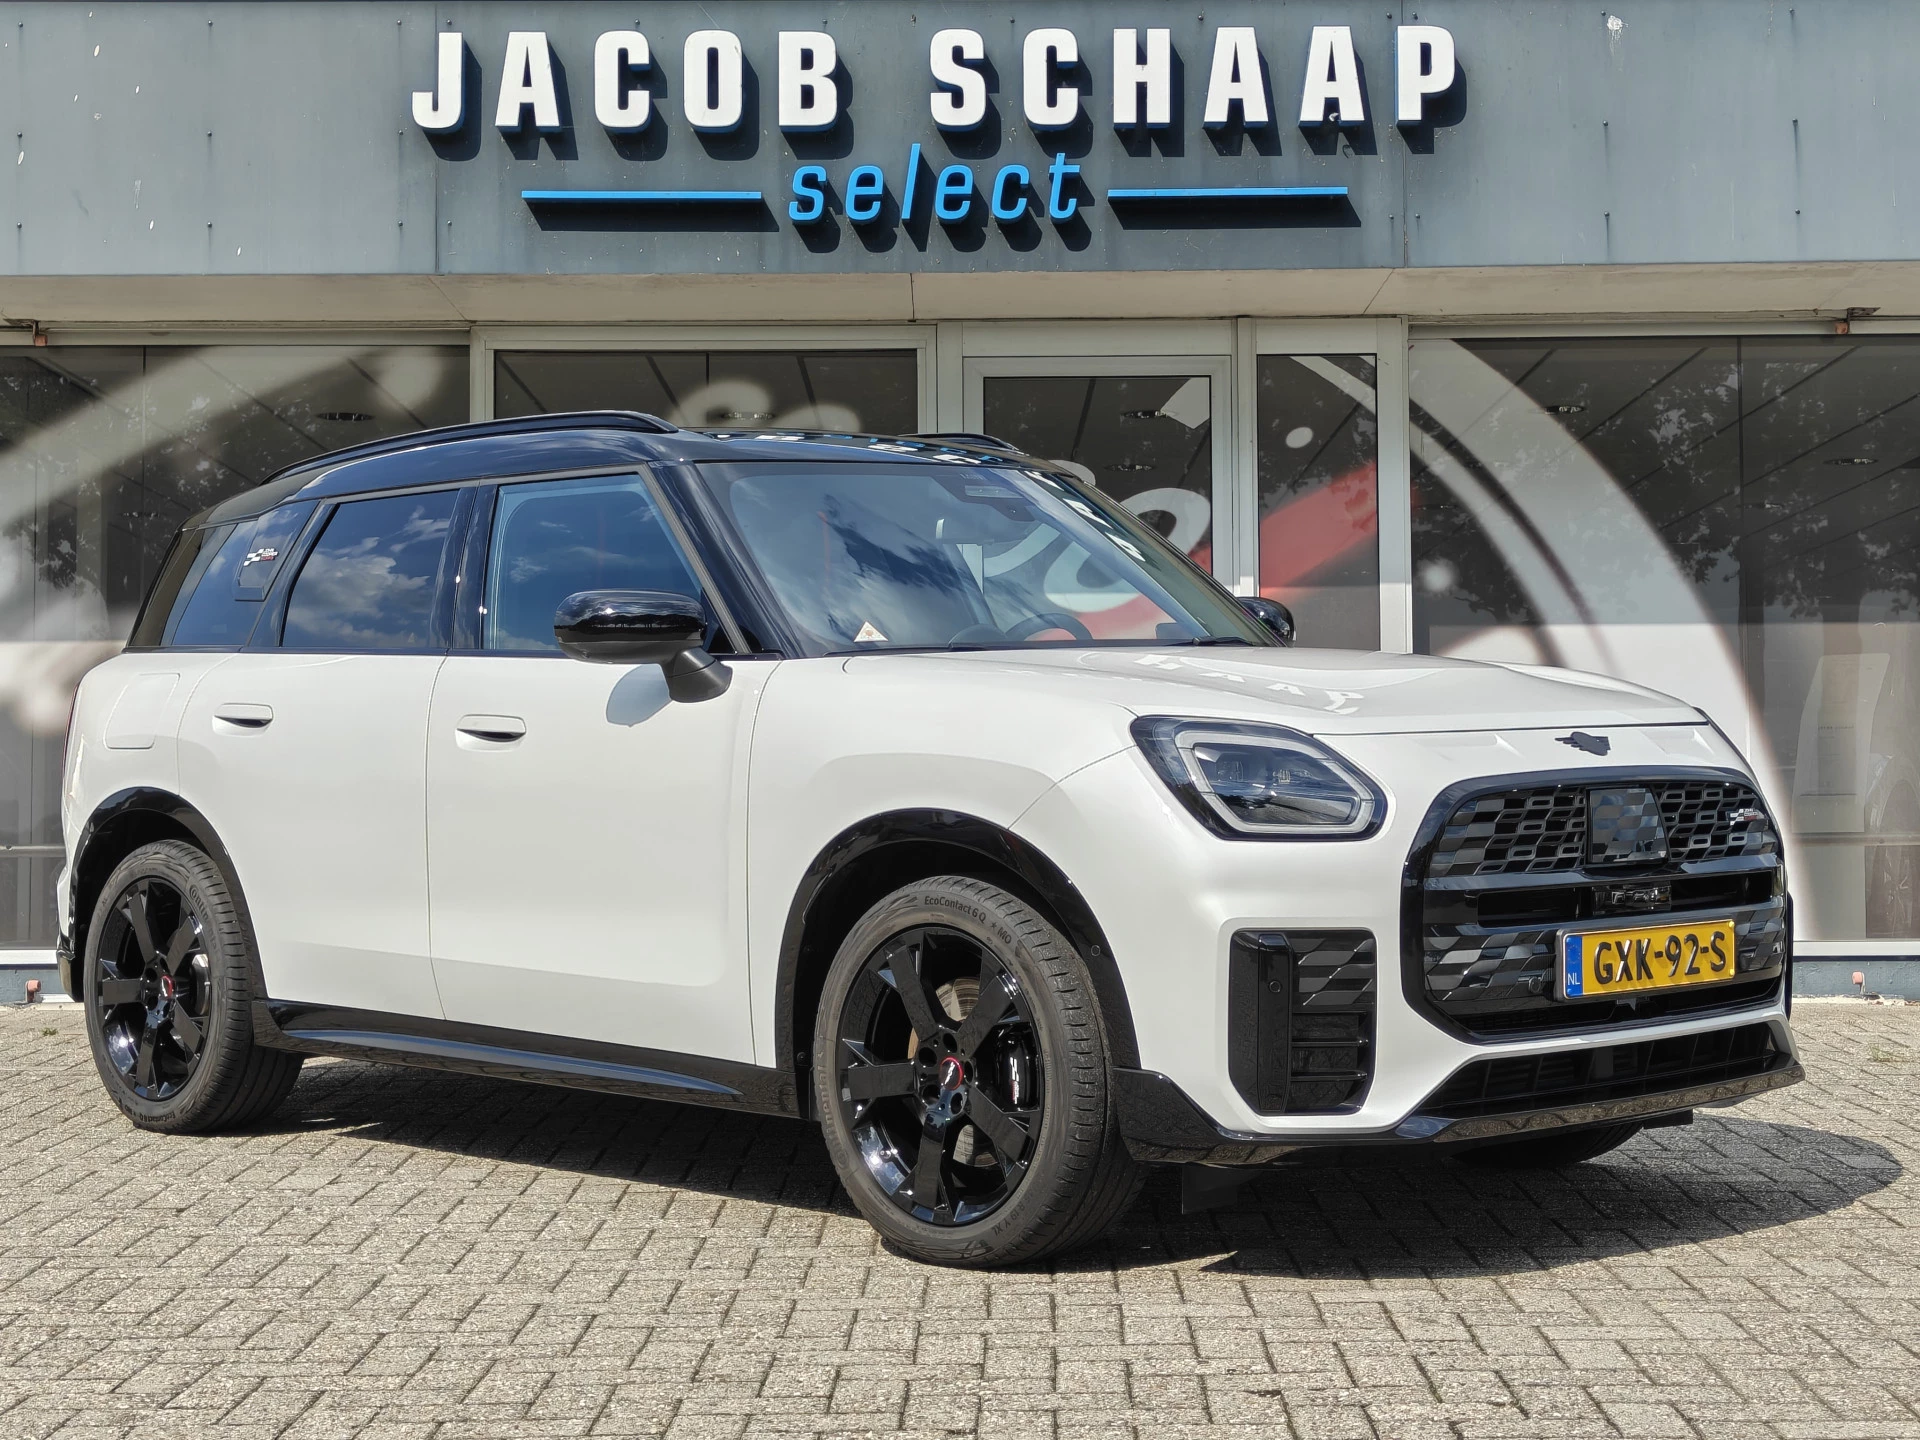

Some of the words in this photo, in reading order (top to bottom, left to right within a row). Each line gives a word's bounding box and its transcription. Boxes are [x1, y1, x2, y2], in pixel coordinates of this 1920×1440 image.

[411, 29, 838, 131] JACOB
[929, 25, 1456, 131] SCHAAP
[788, 143, 1082, 223] select
[924, 895, 972, 915] EcoContact
[971, 907, 979, 918] 6
[978, 912, 987, 924] Q
[1567, 972, 1581, 986] NL
[1593, 931, 1727, 985] GXK-92-S
